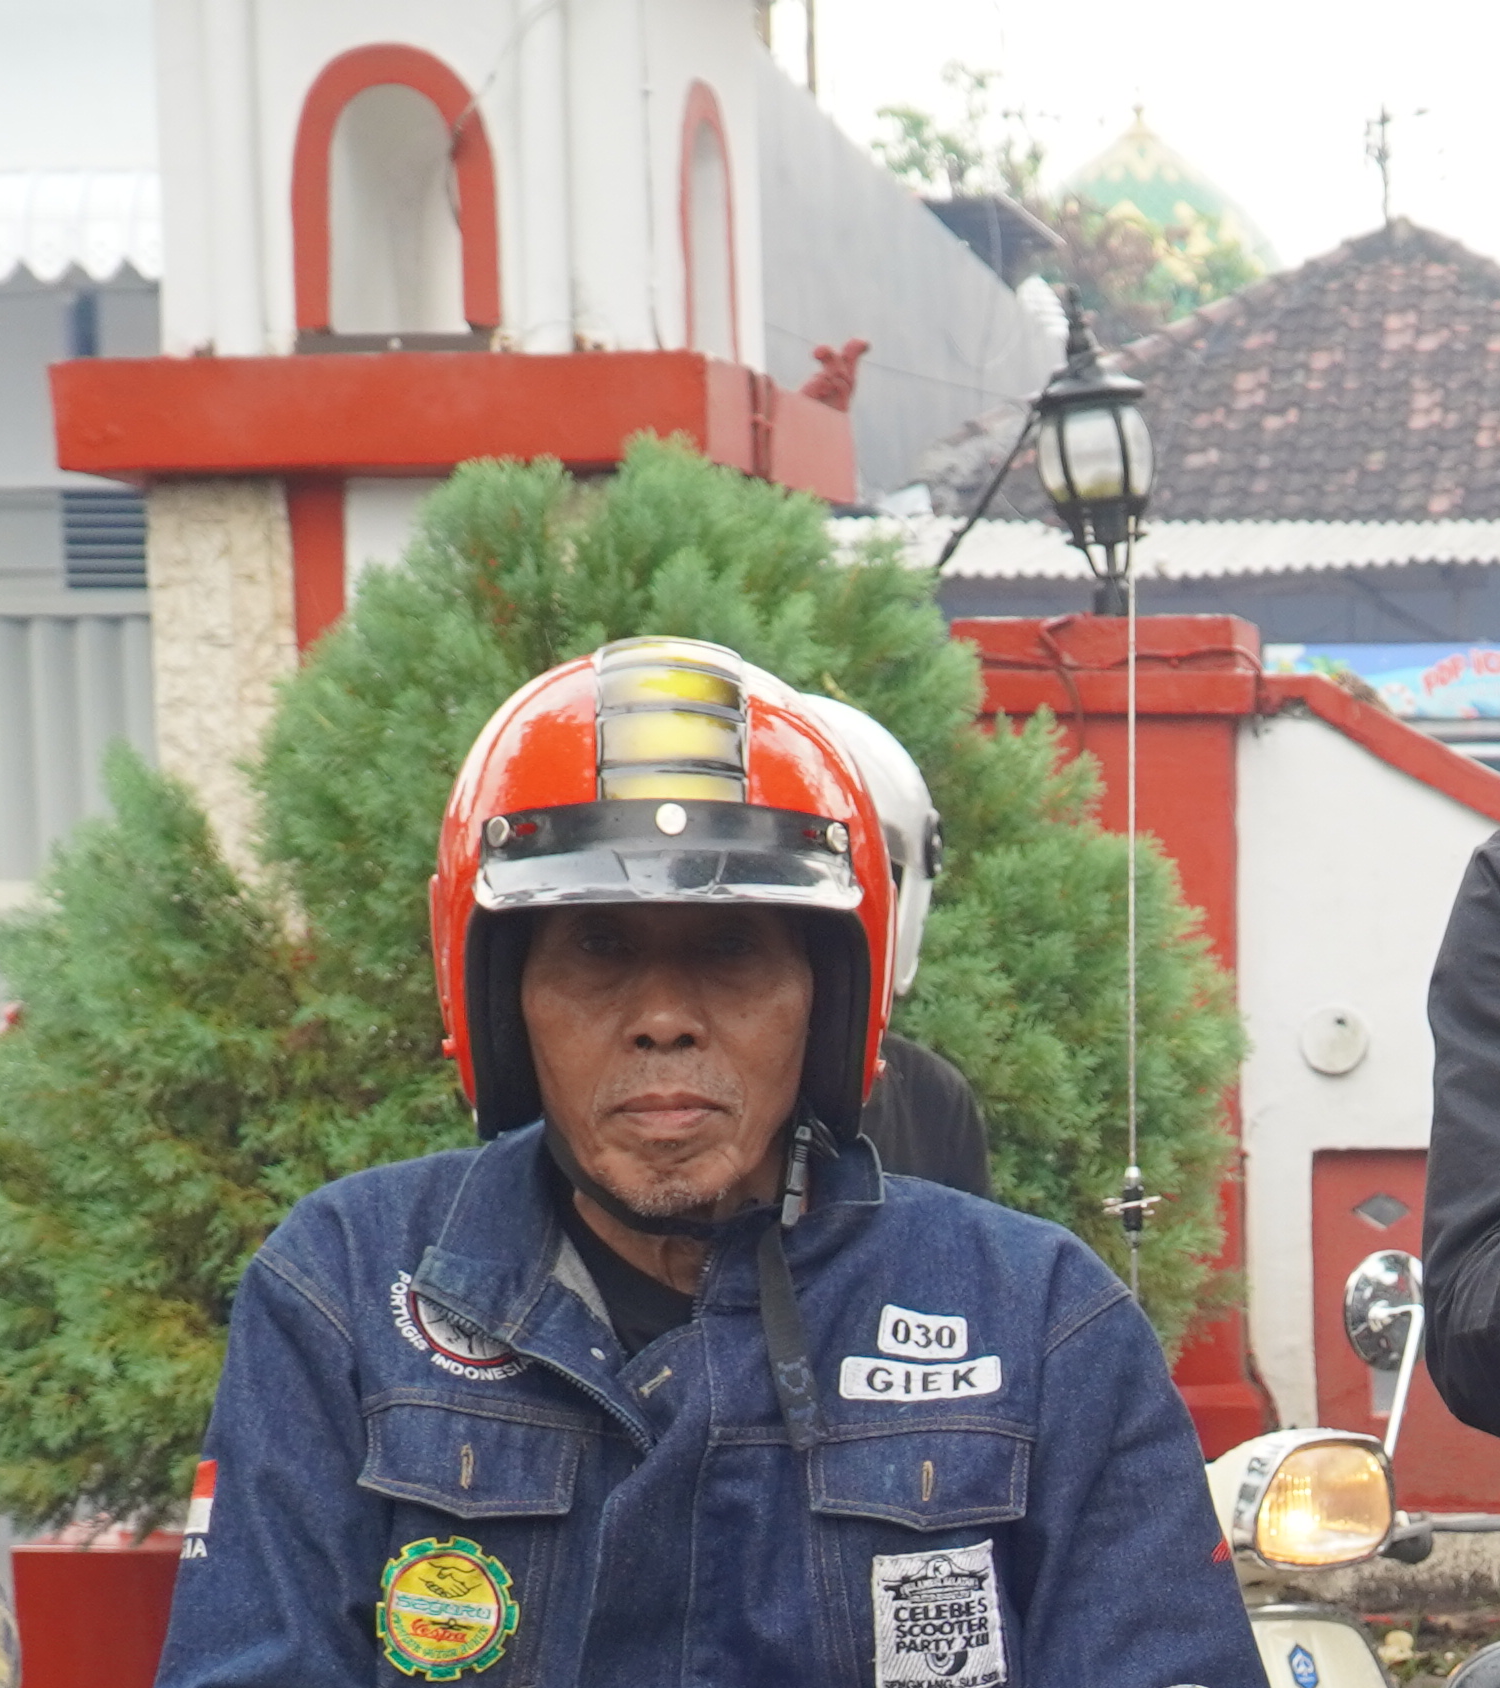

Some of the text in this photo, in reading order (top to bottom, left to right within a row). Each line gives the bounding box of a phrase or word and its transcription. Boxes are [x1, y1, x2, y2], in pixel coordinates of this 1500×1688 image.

[389, 1269, 431, 1351] PORTUGIS
[891, 1318, 957, 1349] 030
[429, 1352, 533, 1382] INDONESIA
[866, 1366, 978, 1395] GIEK
[893, 1596, 989, 1623] CELEBES
[895, 1616, 989, 1640] SCOOTER
[895, 1637, 956, 1655] PARTY
